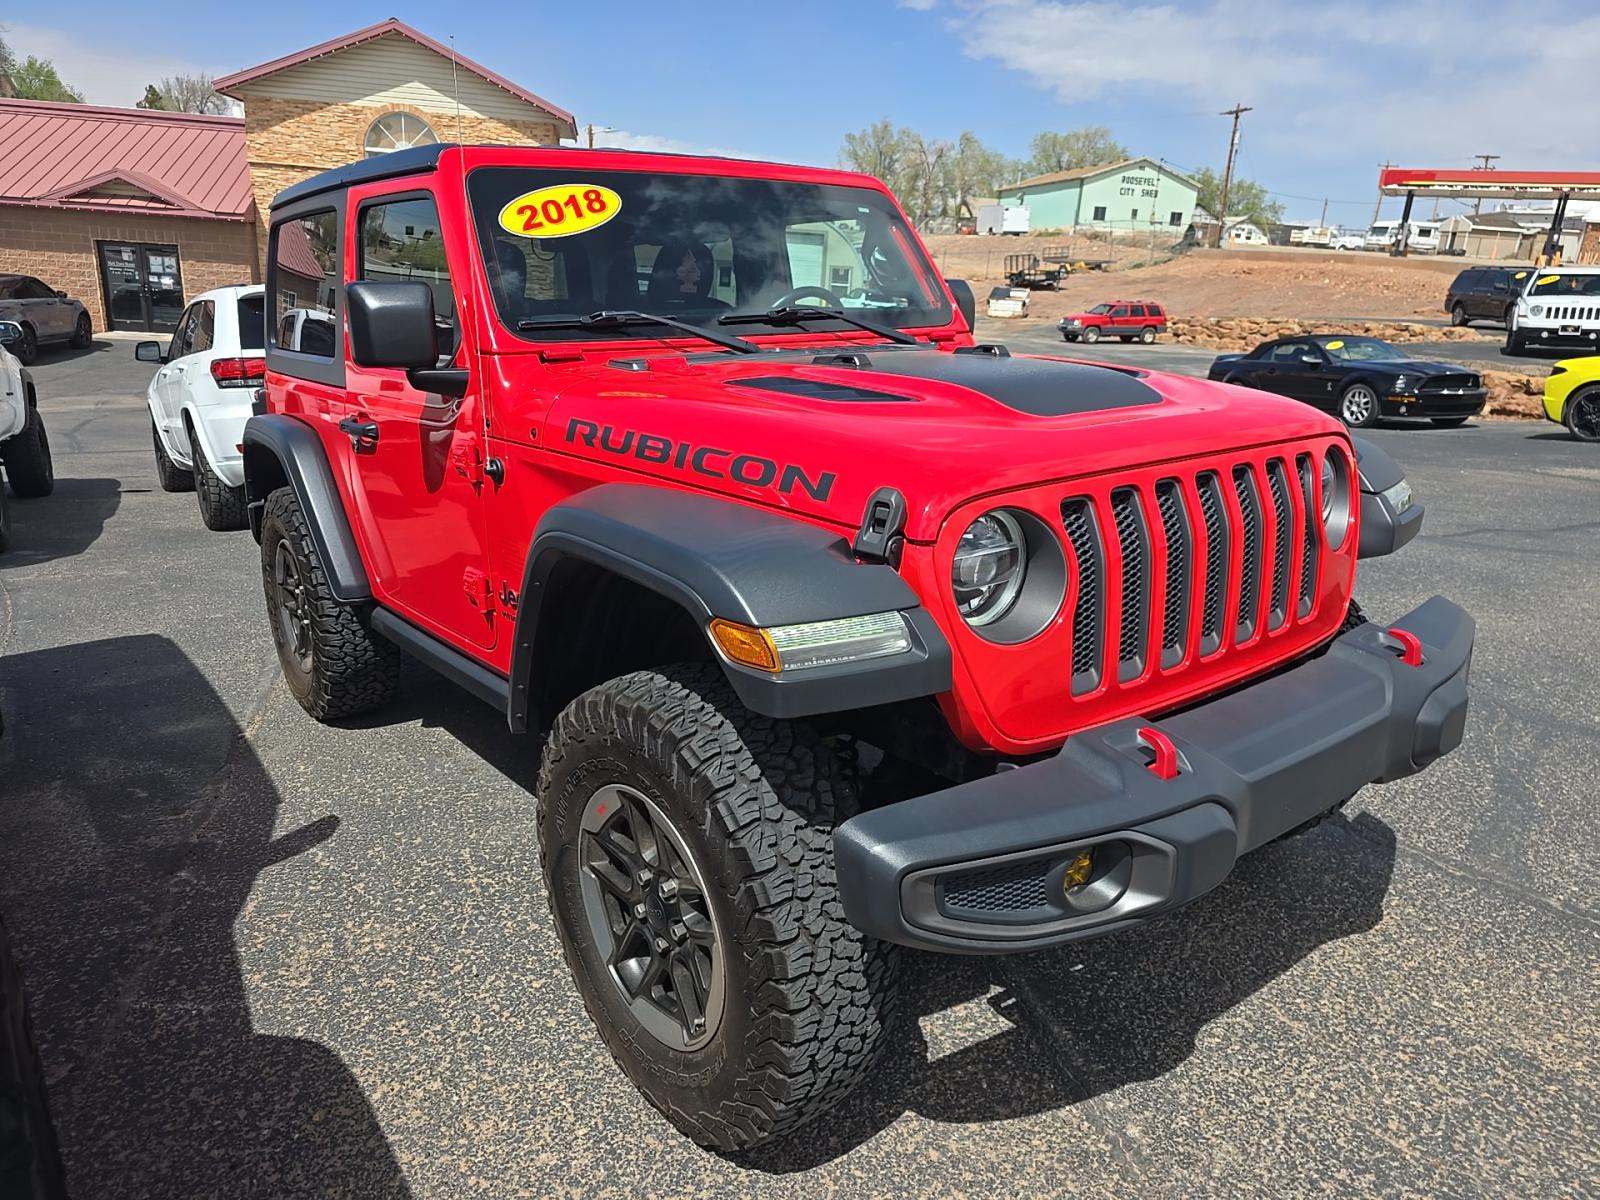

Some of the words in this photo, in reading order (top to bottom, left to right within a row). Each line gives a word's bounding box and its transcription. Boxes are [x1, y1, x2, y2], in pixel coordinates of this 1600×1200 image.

[516, 189, 607, 232] 2018
[1119, 187, 1135, 197] CITY
[565, 418, 837, 503] RUBICON
